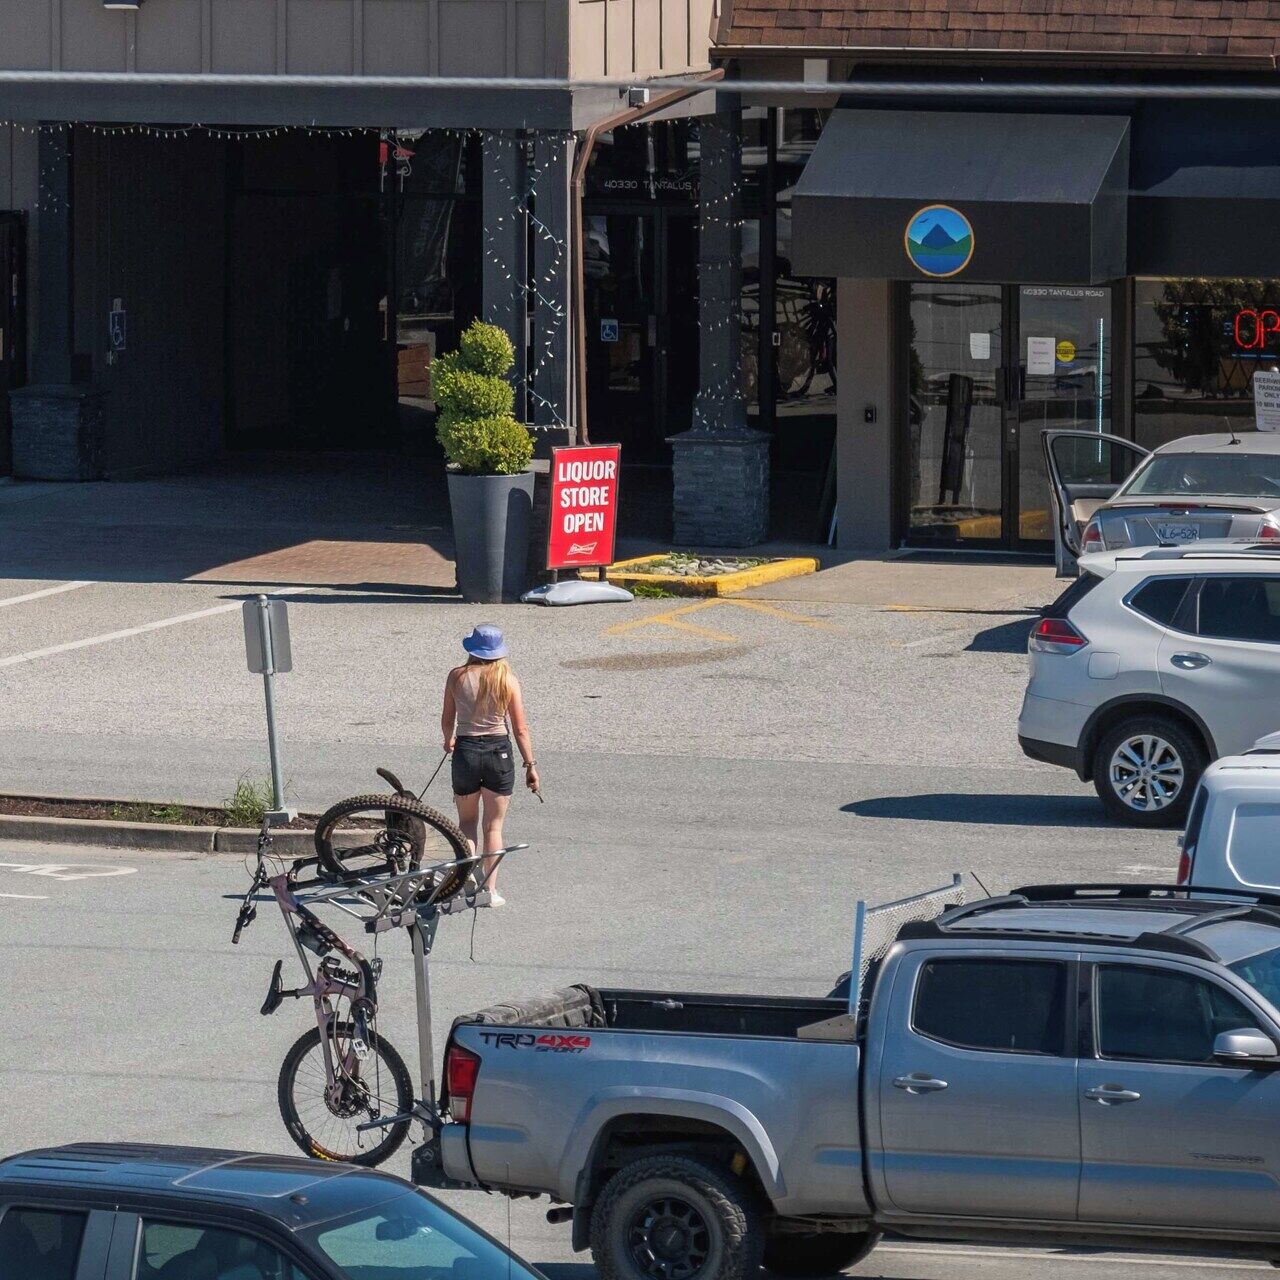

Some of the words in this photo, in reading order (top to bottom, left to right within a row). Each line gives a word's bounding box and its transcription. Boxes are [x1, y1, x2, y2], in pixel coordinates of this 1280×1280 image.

[604, 180, 638, 189] 40330
[643, 181, 692, 190] TANTALUS
[1049, 289, 1084, 297] TANTALUS
[558, 460, 617, 484] LIQUOR
[560, 486, 610, 508] STORE
[563, 512, 604, 534] OPEN
[479, 1032, 535, 1049] TRD
[535, 1046, 587, 1054] SPORT
